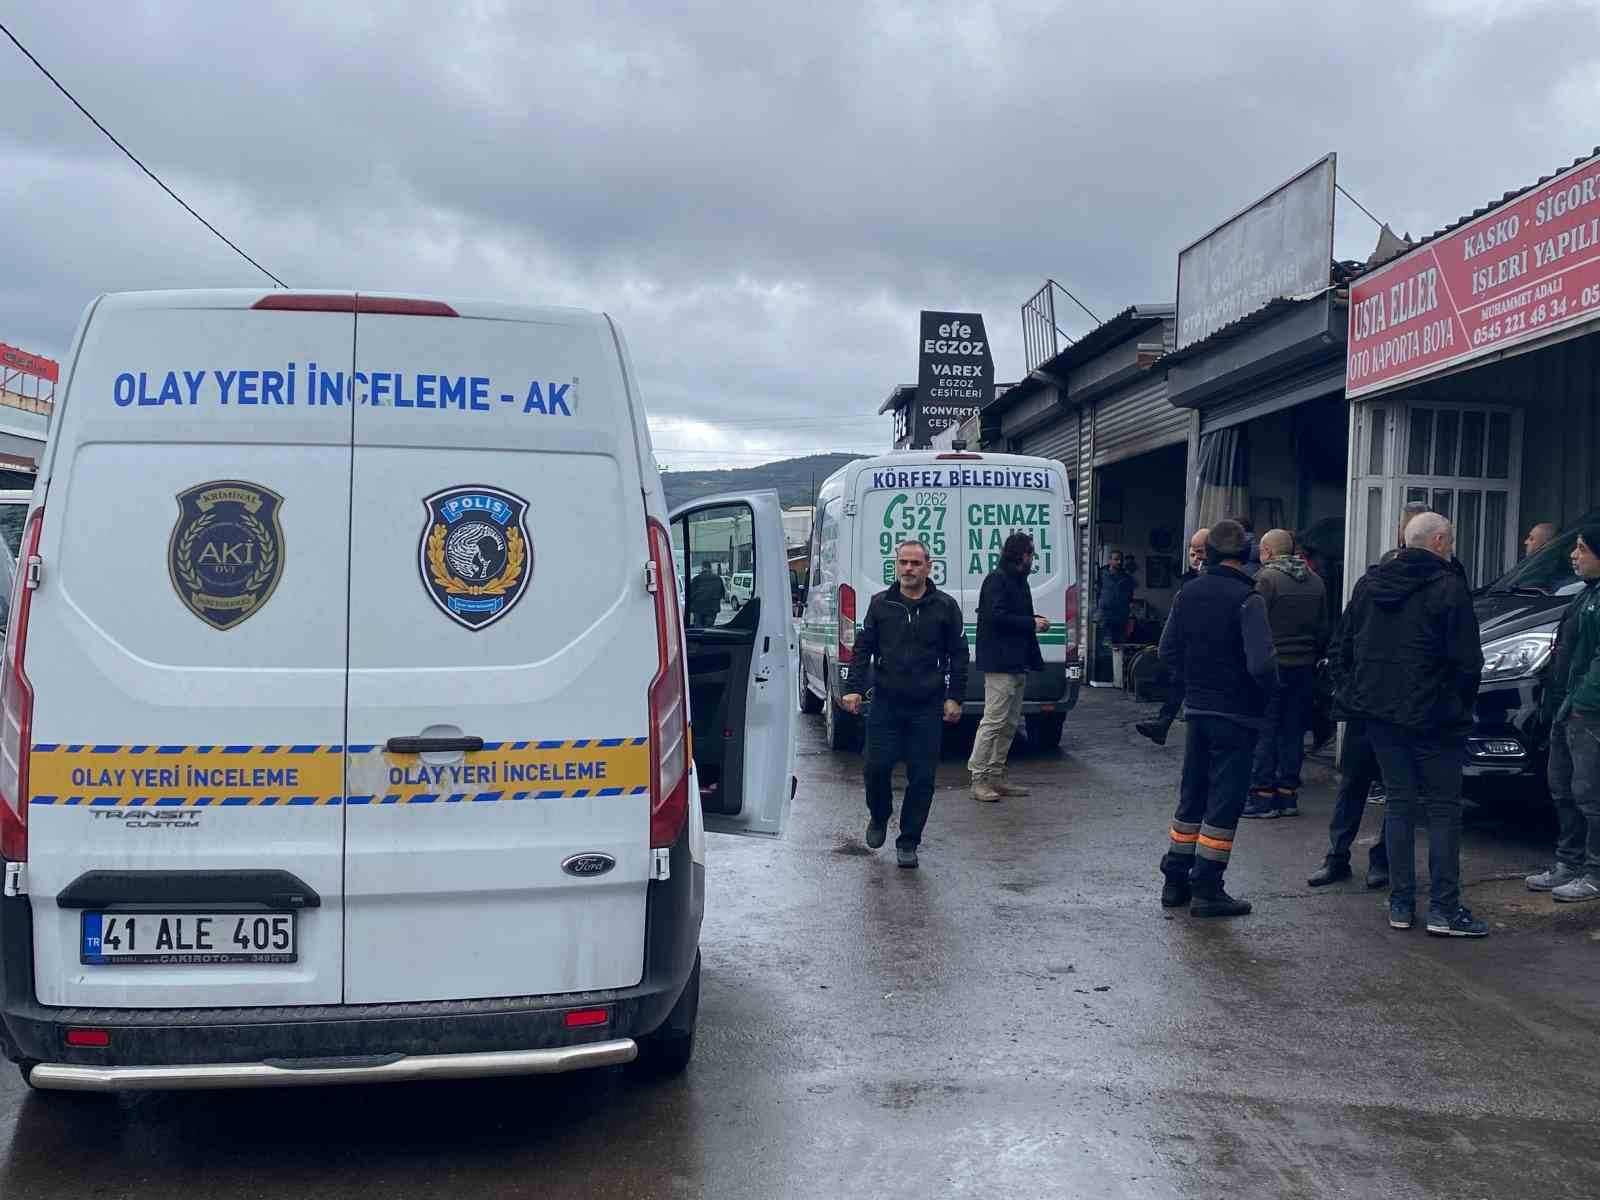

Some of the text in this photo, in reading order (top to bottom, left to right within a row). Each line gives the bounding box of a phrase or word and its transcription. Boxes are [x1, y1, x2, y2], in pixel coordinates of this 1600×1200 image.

[1464, 215, 1519, 260] KASKO
[1472, 244, 1528, 298] İŞLERİ
[1354, 267, 1438, 341] USTA ELLER
[1481, 290, 1533, 321] MUHAMMET
[939, 320, 971, 338] efe
[1473, 321, 1501, 344] 0545
[1505, 311, 1526, 334] 221
[1530, 304, 1546, 325] 48
[1550, 296, 1567, 317] 34
[924, 339, 984, 355] EGZOZ
[1350, 317, 1454, 380] OTO KAPORTA BOYA
[931, 364, 982, 377] VAREX
[113, 371, 206, 407] OLAY
[214, 362, 296, 405] YERİ
[940, 379, 974, 388] EGZOZ
[873, 467, 1049, 489] KÖRFEZ BELEDİYESİ
[449, 497, 503, 513] POLİS
[915, 492, 947, 506] 0262
[902, 507, 947, 530] 527
[968, 503, 1050, 526] CENAZE
[969, 528, 1052, 550] NAL
[198, 539, 255, 564] AKİ
[71, 765, 298, 787] OLAY YERİ İNCELEME
[389, 760, 607, 785] OLAY YERİ İNCELEME
[89, 809, 203, 819] TRANSIT
[573, 857, 604, 873] Ford
[87, 918, 289, 951] TR 41 ALE 405
